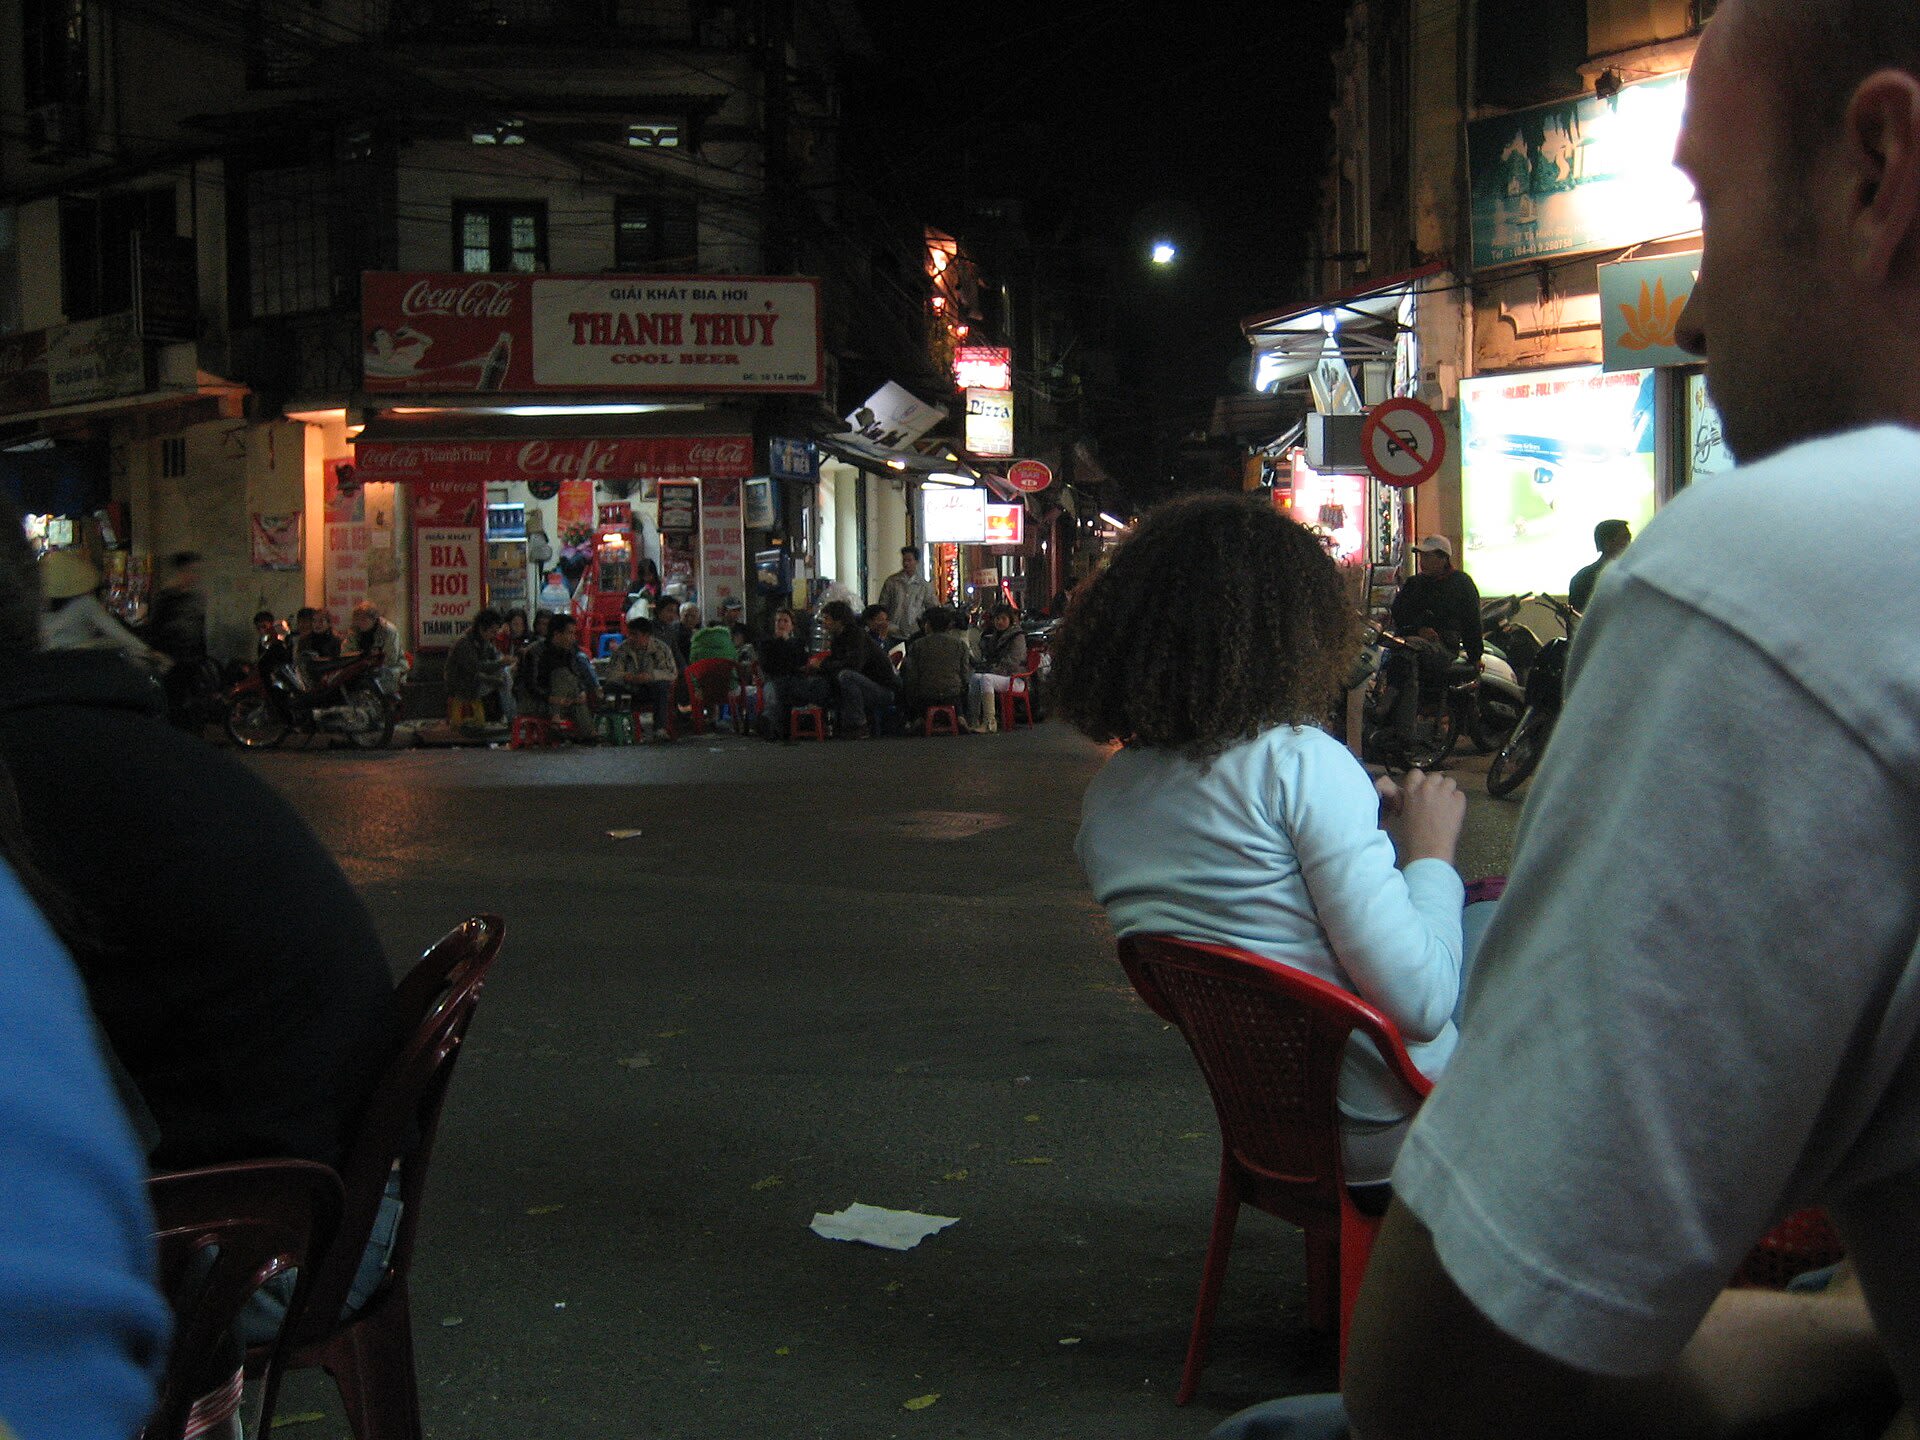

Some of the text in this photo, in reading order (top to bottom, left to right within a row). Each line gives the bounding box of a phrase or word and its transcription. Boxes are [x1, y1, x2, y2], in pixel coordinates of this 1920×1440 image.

[646, 286, 688, 301] KHÁT
[692, 288, 718, 301] BIA
[568, 312, 684, 347] THANH
[611, 353, 740, 365] COOL BEER
[517, 439, 619, 480] Café
[431, 545, 468, 567] BIA
[423, 620, 453, 636] THANH
